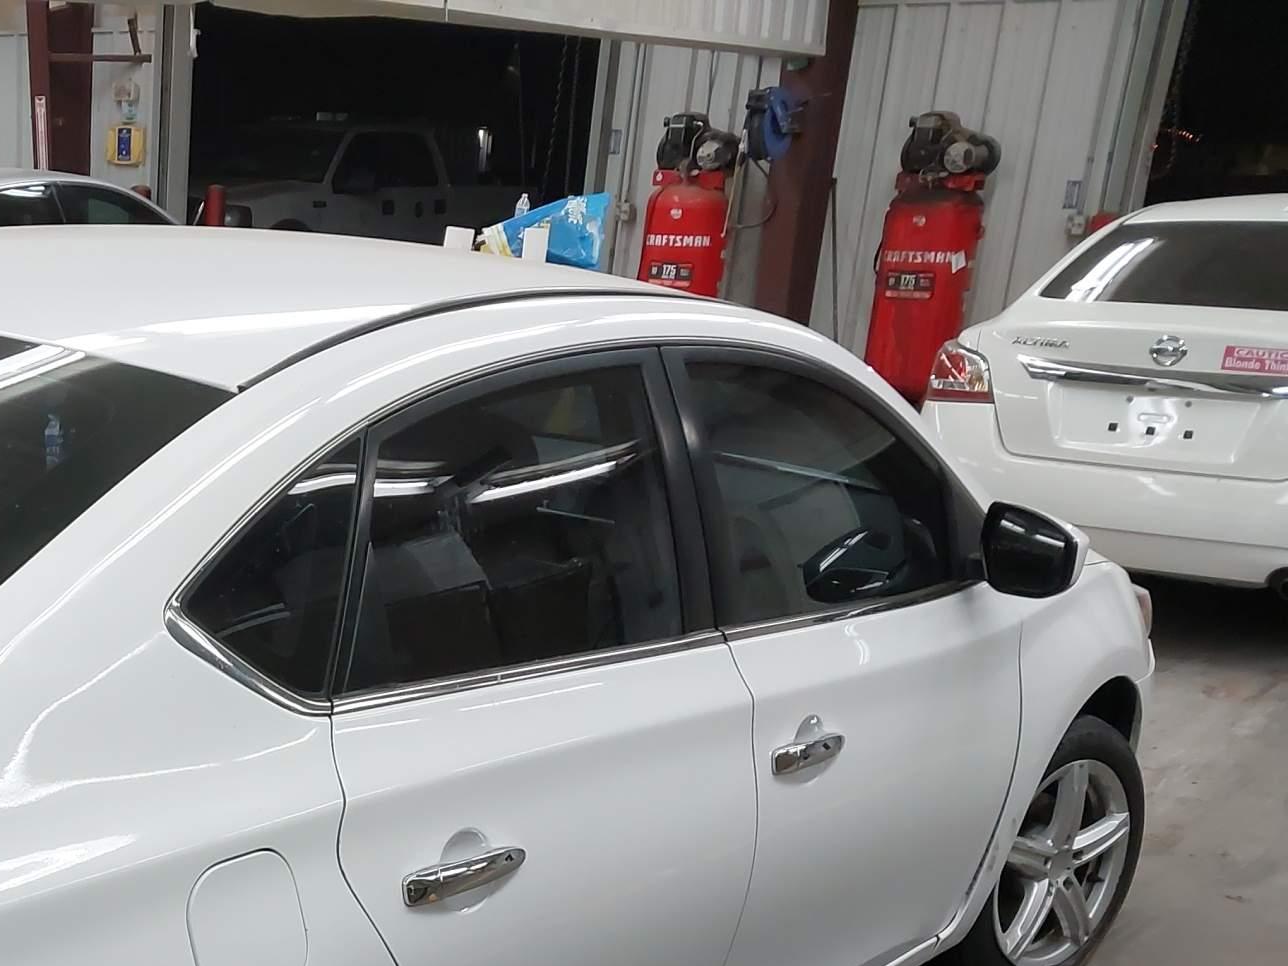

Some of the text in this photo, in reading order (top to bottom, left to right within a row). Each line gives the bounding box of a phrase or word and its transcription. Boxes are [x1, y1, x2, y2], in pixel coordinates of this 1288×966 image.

[646, 234, 711, 247] CRAFTSMAN
[662, 264, 677, 275] 175
[1224, 356, 1261, 370] Blonde
